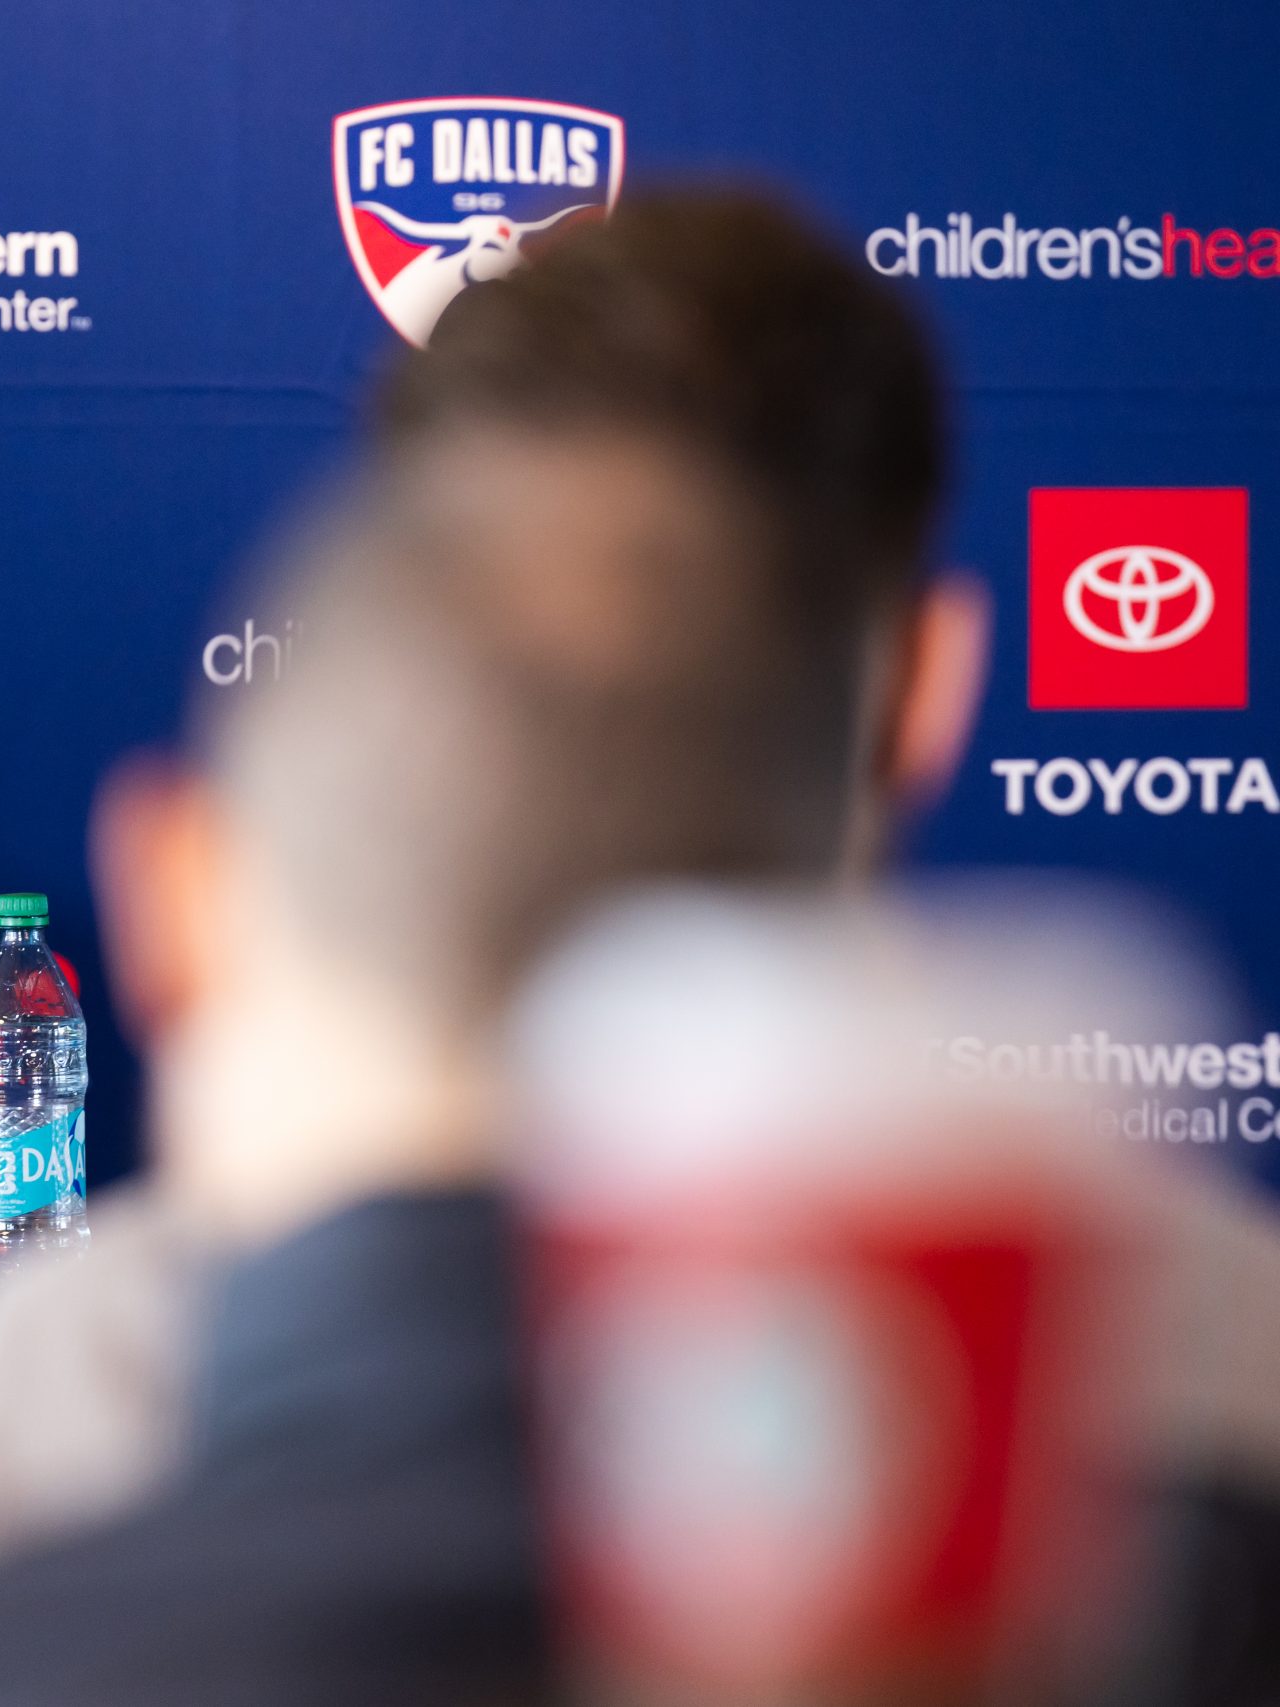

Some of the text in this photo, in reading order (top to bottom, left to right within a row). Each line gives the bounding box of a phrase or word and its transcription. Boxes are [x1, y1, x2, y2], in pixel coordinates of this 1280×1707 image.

[359, 117, 598, 192] FC DALLAS
[451, 192, 506, 212] 96
[990, 756, 1280, 816] TOYOTA
[22, 1135, 86, 1193] DASA
